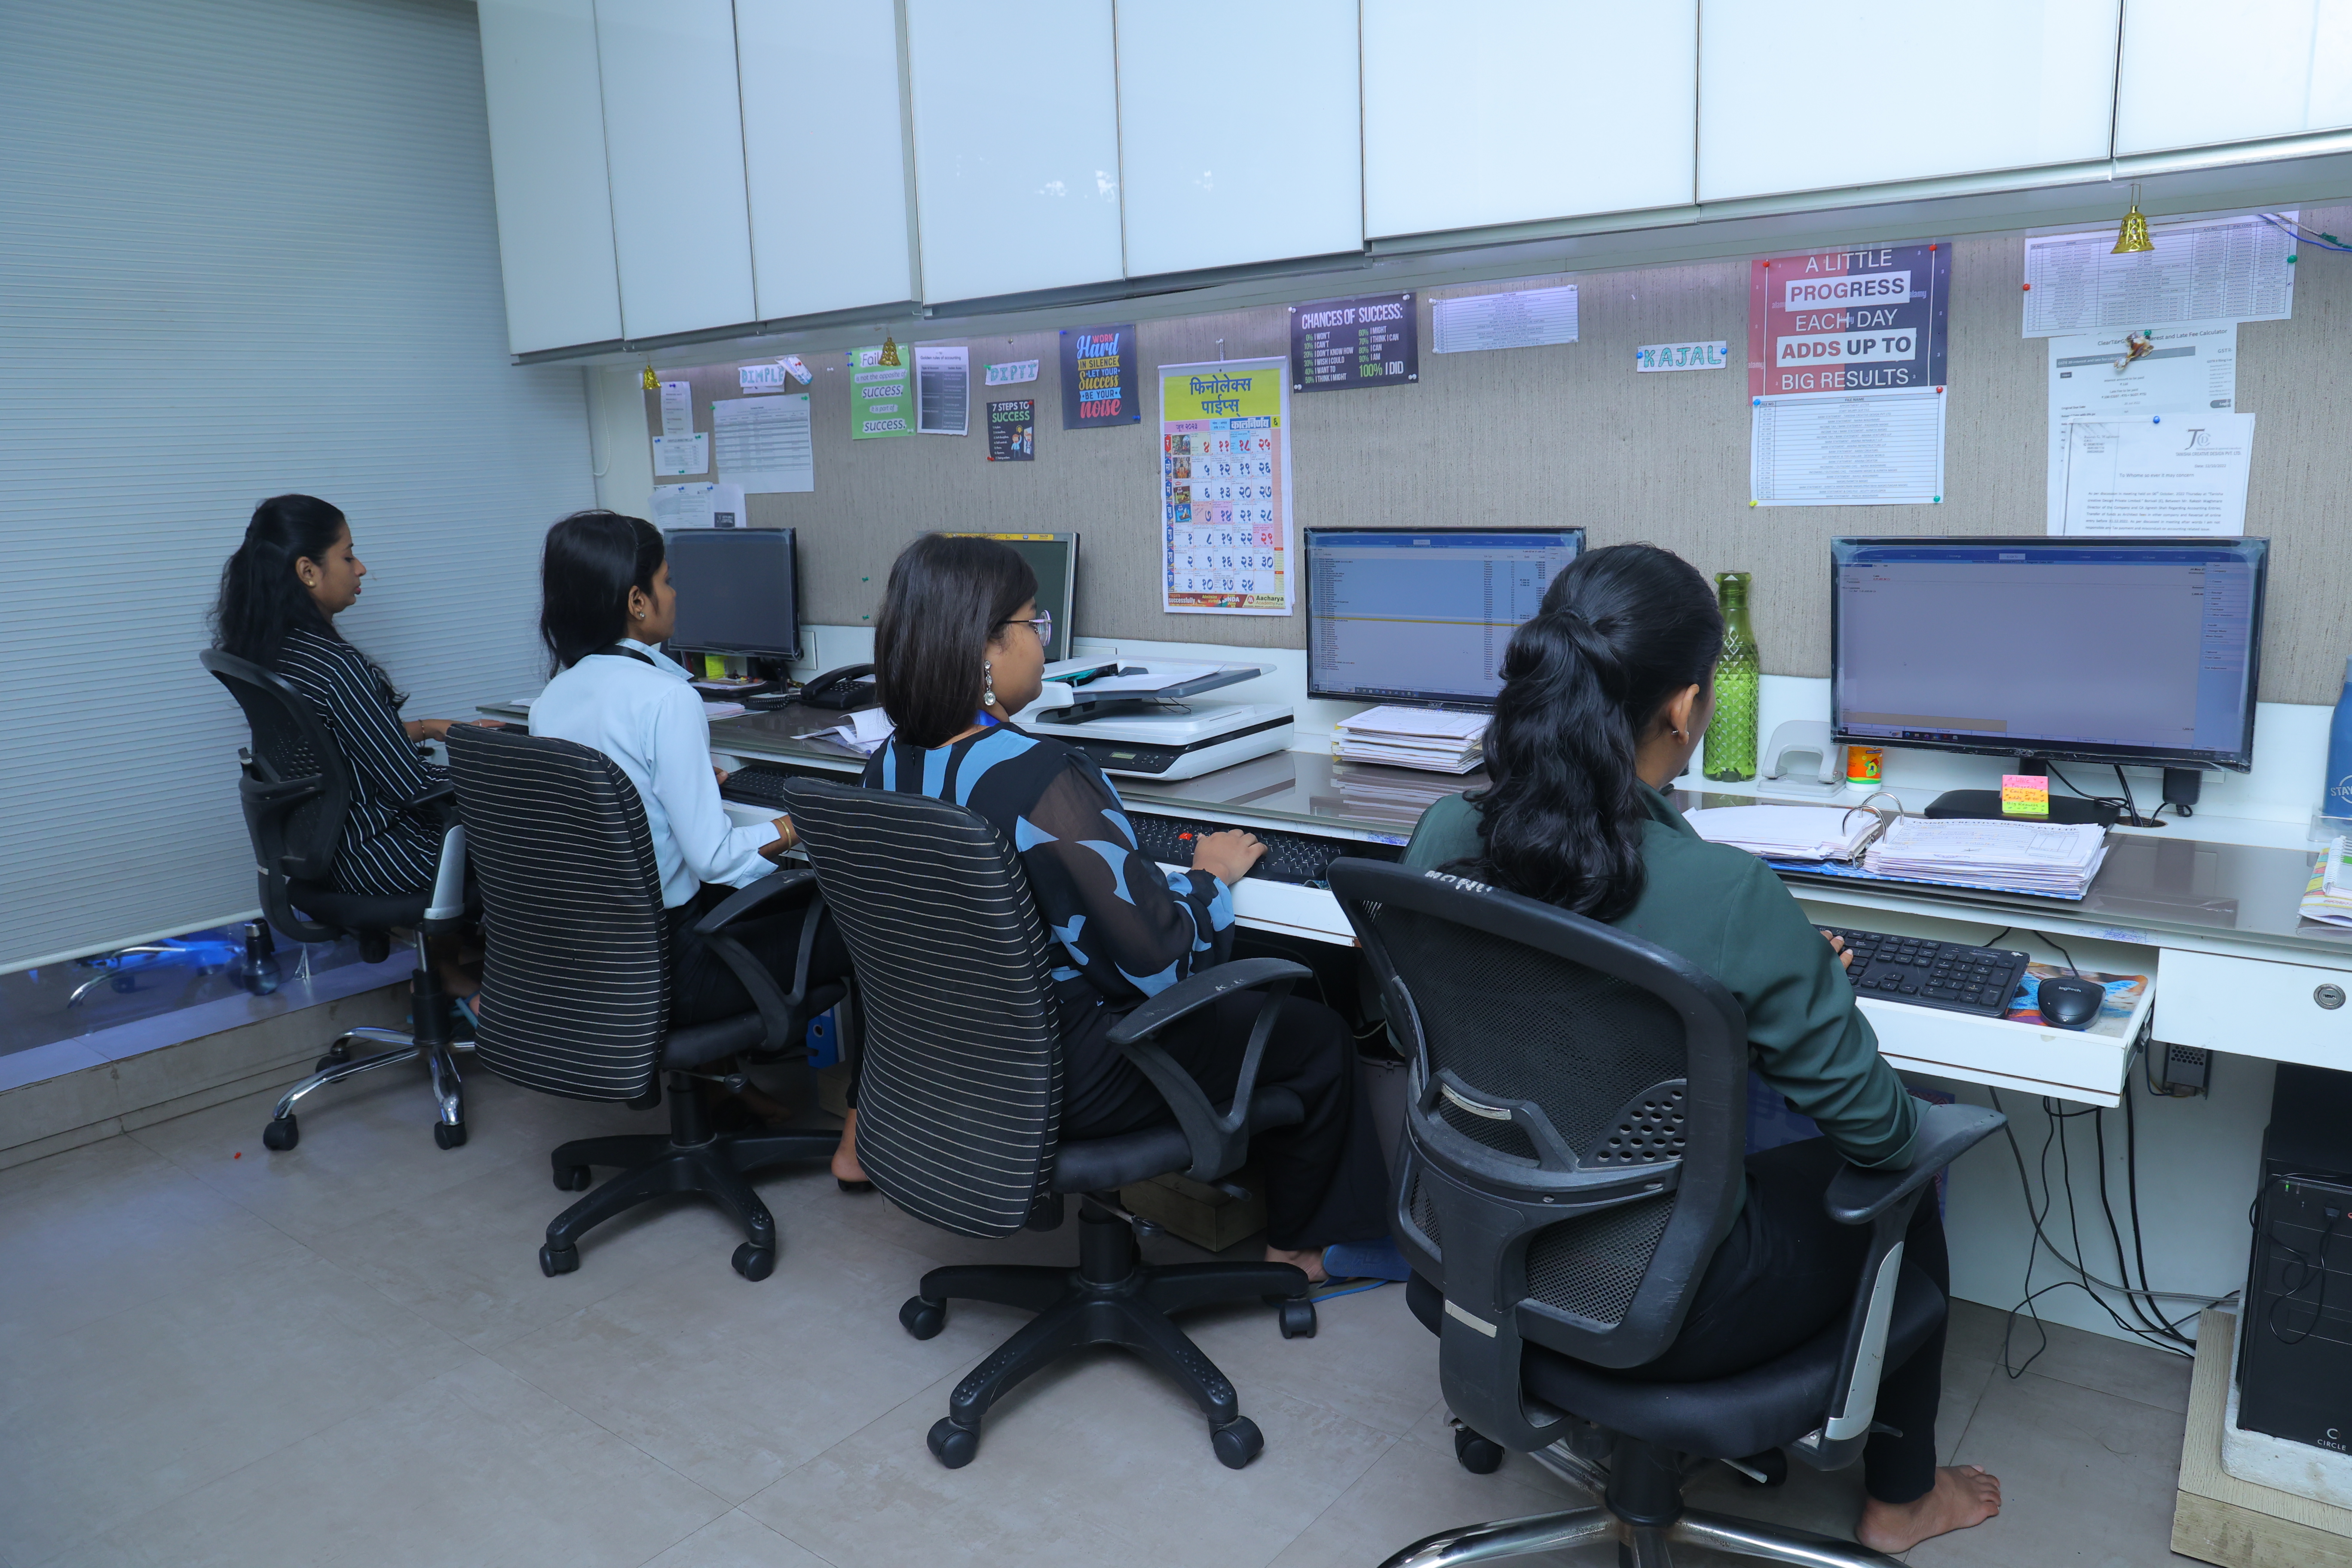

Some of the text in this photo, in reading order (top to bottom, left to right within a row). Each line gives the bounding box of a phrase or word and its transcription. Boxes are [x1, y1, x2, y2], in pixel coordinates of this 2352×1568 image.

[1805, 250, 1892, 273] A LITTLE
[1792, 278, 1904, 302] PROGRESS
[1302, 303, 1403, 329] CHANCES OF SUCCESS:
[1796, 309, 1898, 331] EACH DAY
[1373, 326, 1386, 334] MIGHT
[1092, 334, 1113, 343] WORK
[1077, 333, 1119, 359] Hard
[1330, 348, 1342, 356] KNOW
[1782, 337, 1911, 359] ADDS UP TO
[1080, 357, 1116, 368] IN SILENCE
[1644, 346, 1721, 368] KAJAL
[741, 366, 784, 383] DIMPLE
[990, 364, 1036, 381] DIPTI
[1359, 363, 1382, 377] 100%
[1390, 361, 1403, 375] DID
[879, 372, 900, 380] opposite
[1079, 371, 1119, 390] Success
[1782, 368, 1909, 390] BIG RESULTS
[1190, 374, 1252, 395] फिनोलेक्स
[863, 386, 903, 398] success.
[992, 401, 1029, 411] 7 STEPS TO
[1080, 399, 1121, 419] noise
[992, 410, 1029, 423] SUCCESS
[1274, 418, 1277, 426] ६
[864, 420, 905, 431] success.
[1231, 418, 1269, 429] कालनिर्णय
[1204, 439, 1270, 453] ४ ११ १८ २५
[1204, 462, 1271, 475] ५ १२ १९ २६
[1205, 486, 1271, 499] ६ १३ २० २७
[1188, 579, 1253, 591] ३ १० १७ २४
[2317, 1439, 2346, 1451] CIRCLE
